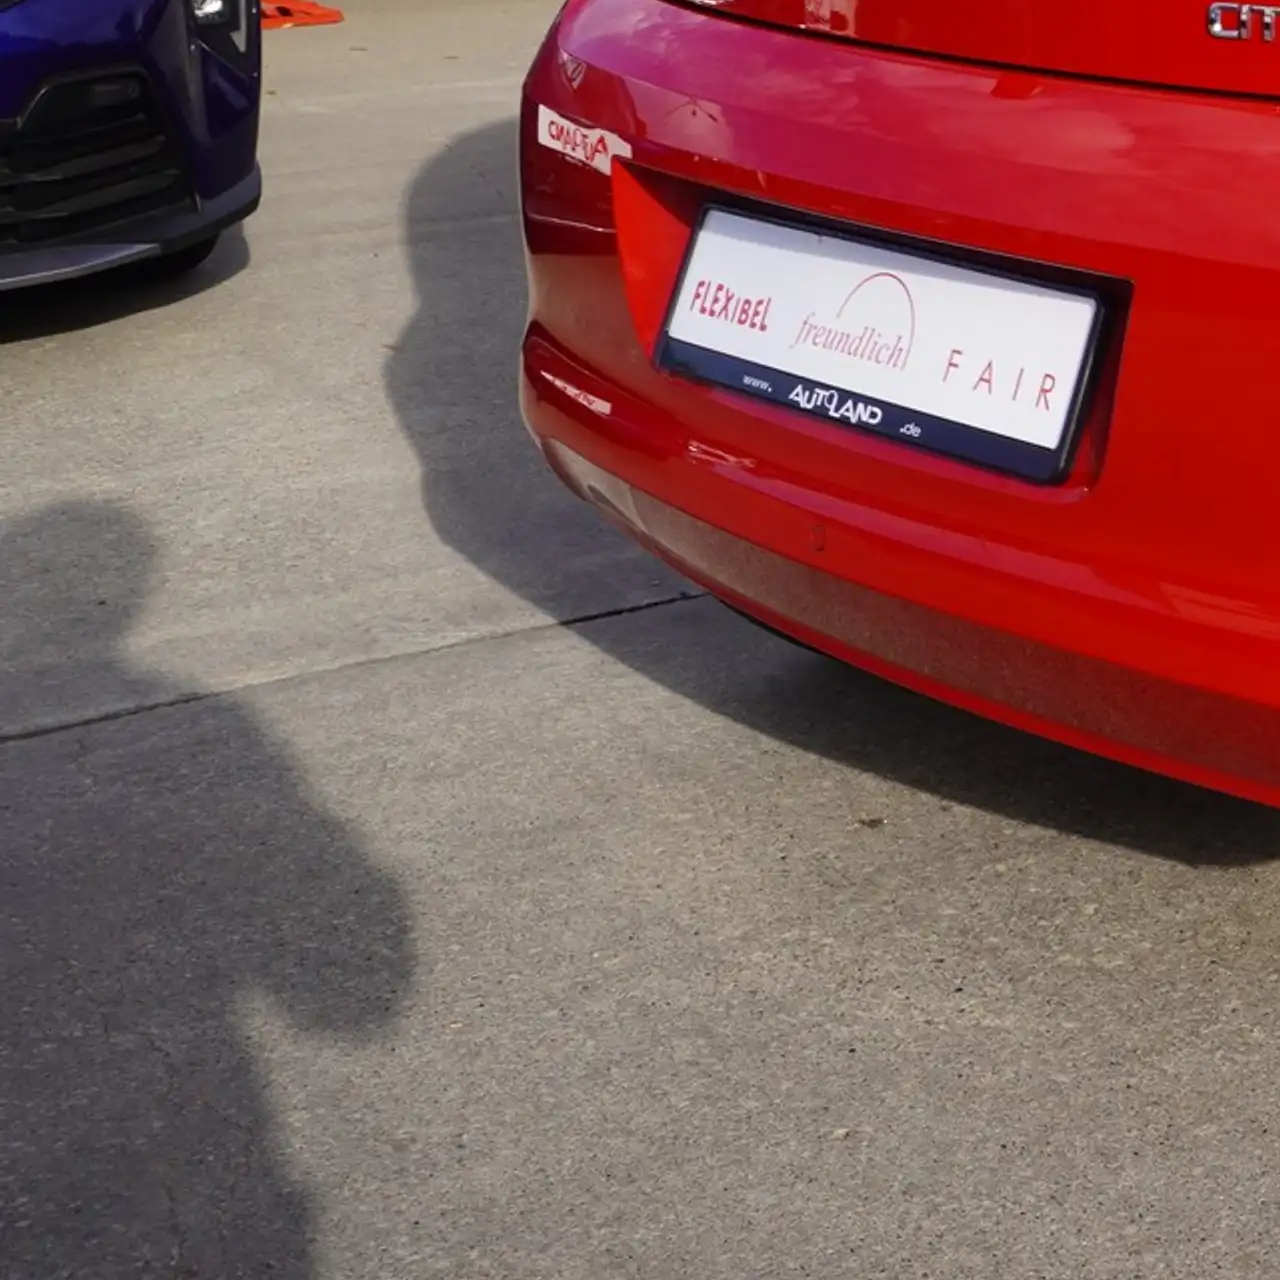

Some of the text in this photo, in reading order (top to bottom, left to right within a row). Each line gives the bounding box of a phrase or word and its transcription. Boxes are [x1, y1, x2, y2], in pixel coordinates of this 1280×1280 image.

[690, 279, 1057, 412] FLEXIBEL freundlich FAIR
[743, 374, 922, 438] www. AUTOLAND .de
